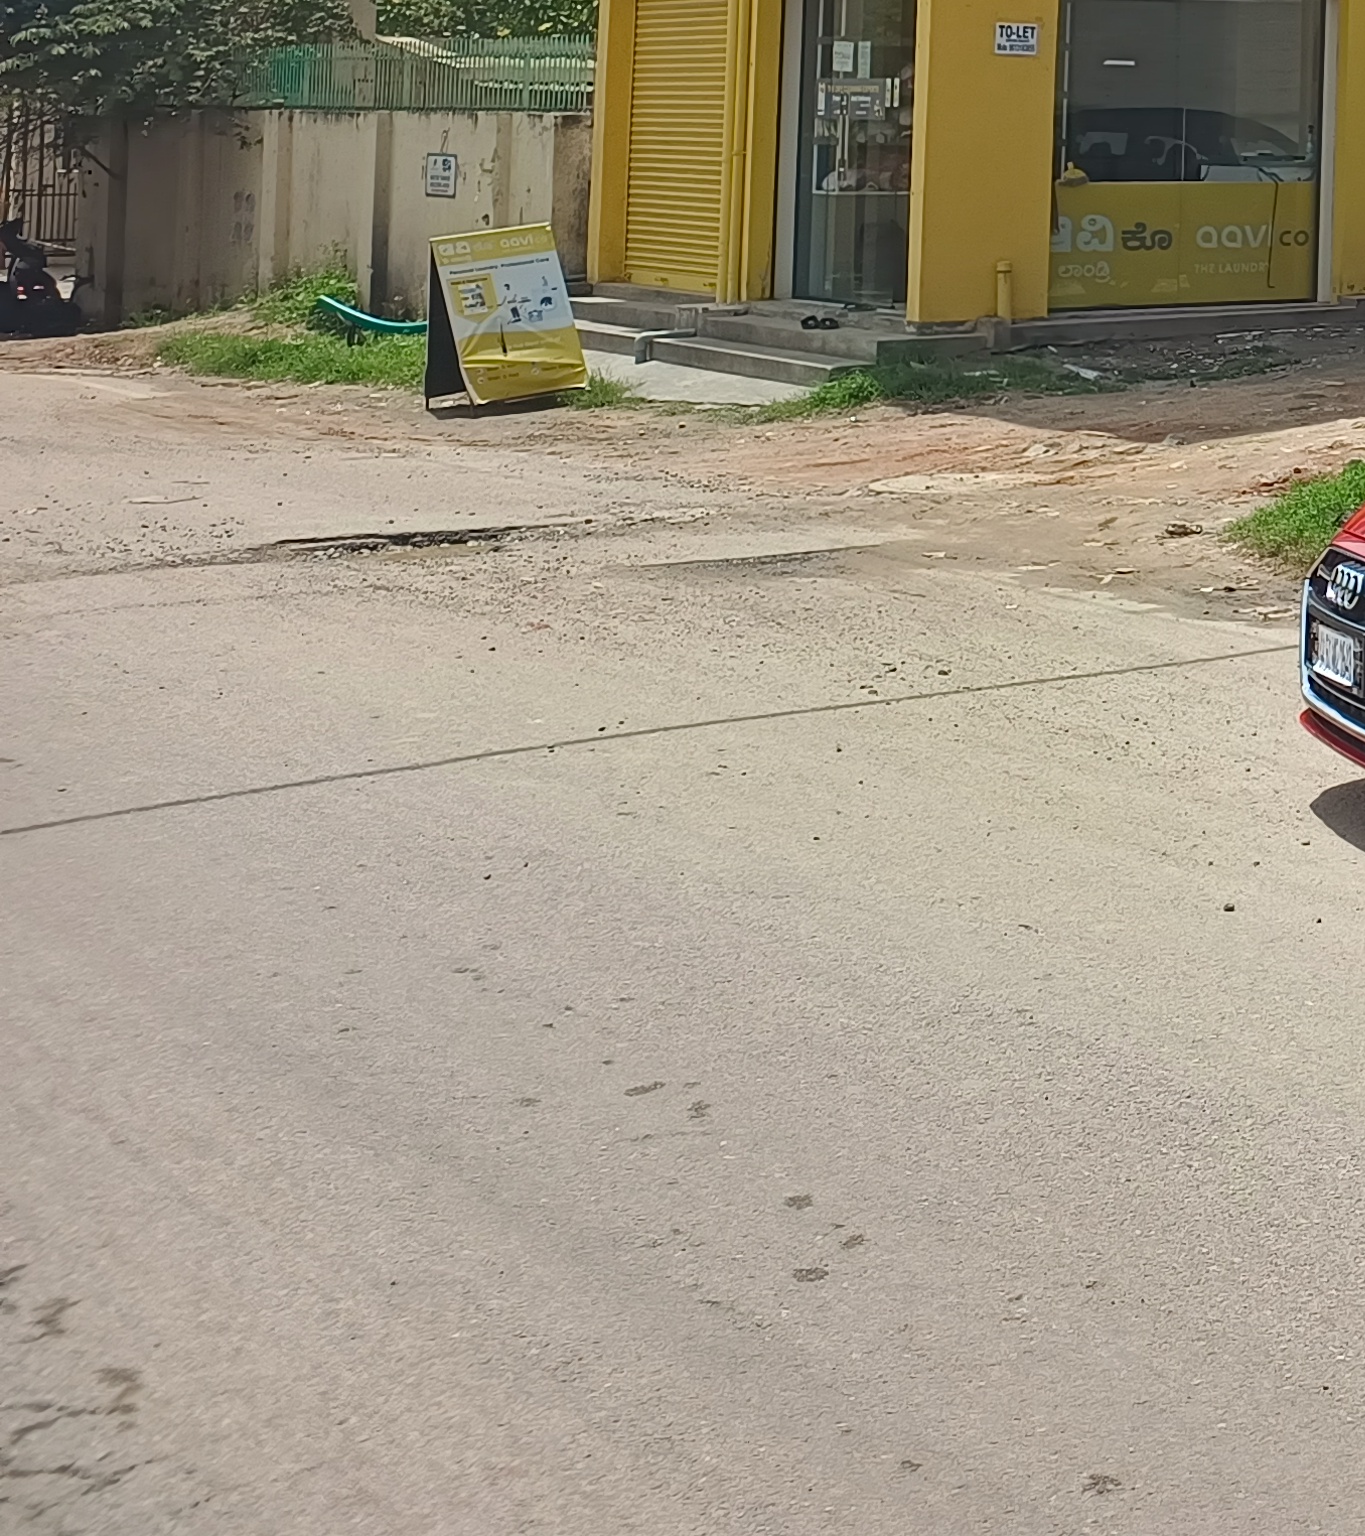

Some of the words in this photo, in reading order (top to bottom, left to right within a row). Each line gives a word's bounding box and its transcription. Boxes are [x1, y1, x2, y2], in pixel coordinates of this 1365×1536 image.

[999, 24, 1036, 39] TO-LET
[1279, 230, 1310, 247] co
[1194, 263, 1217, 274] THE
